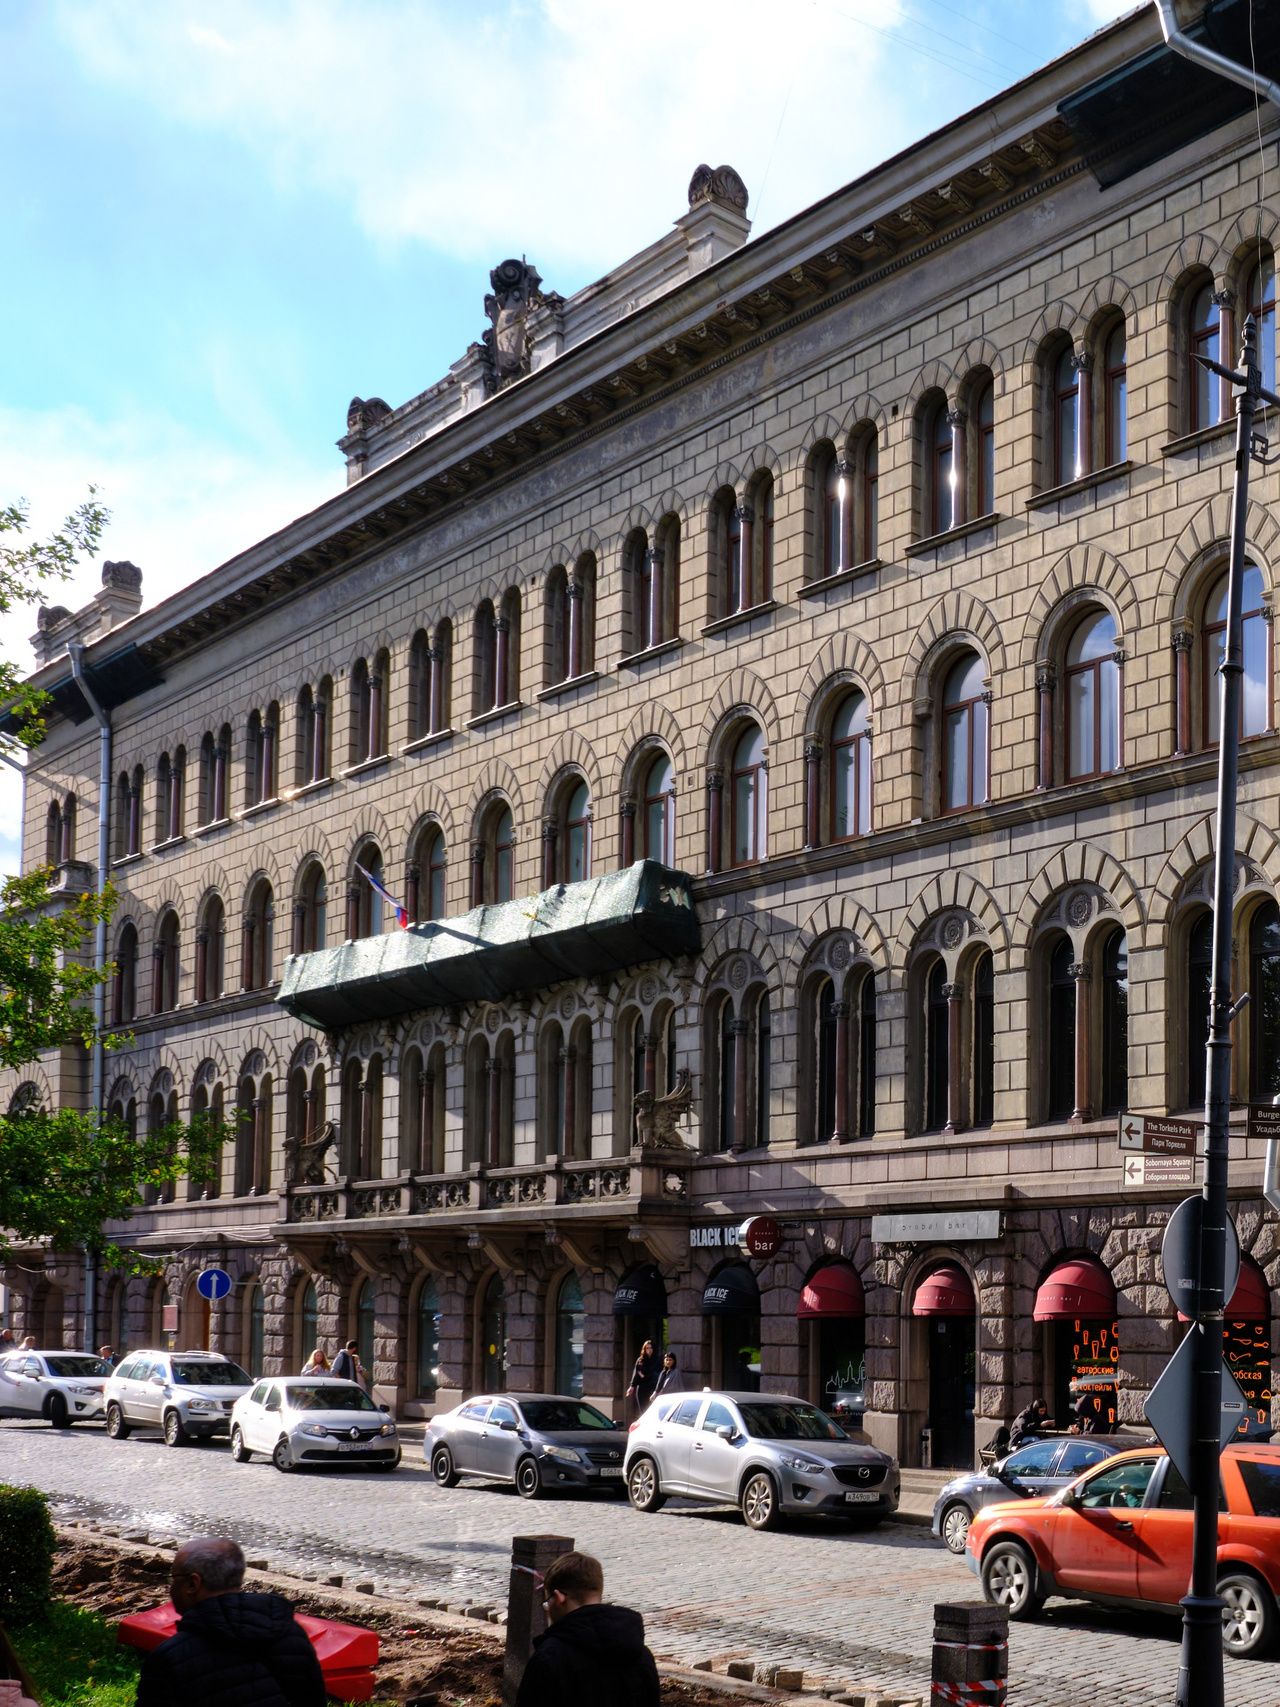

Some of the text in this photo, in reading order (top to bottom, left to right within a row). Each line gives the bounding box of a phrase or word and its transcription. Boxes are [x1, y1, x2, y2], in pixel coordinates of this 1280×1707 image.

[1147, 1122, 1191, 1135] The Torkels Park
[1151, 1138, 1186, 1149] Парк Торкеля
[1145, 1158, 1191, 1168] Sobornaya Square
[1145, 1172, 1190, 1181] Соборная площадь
[690, 1226, 740, 1247] BLACK ICE
[754, 1240, 774, 1250] bar
[716, 1287, 729, 1299] ICE
[1077, 1366, 1115, 1376] авторские
[1079, 1382, 1112, 1391] коктейли
